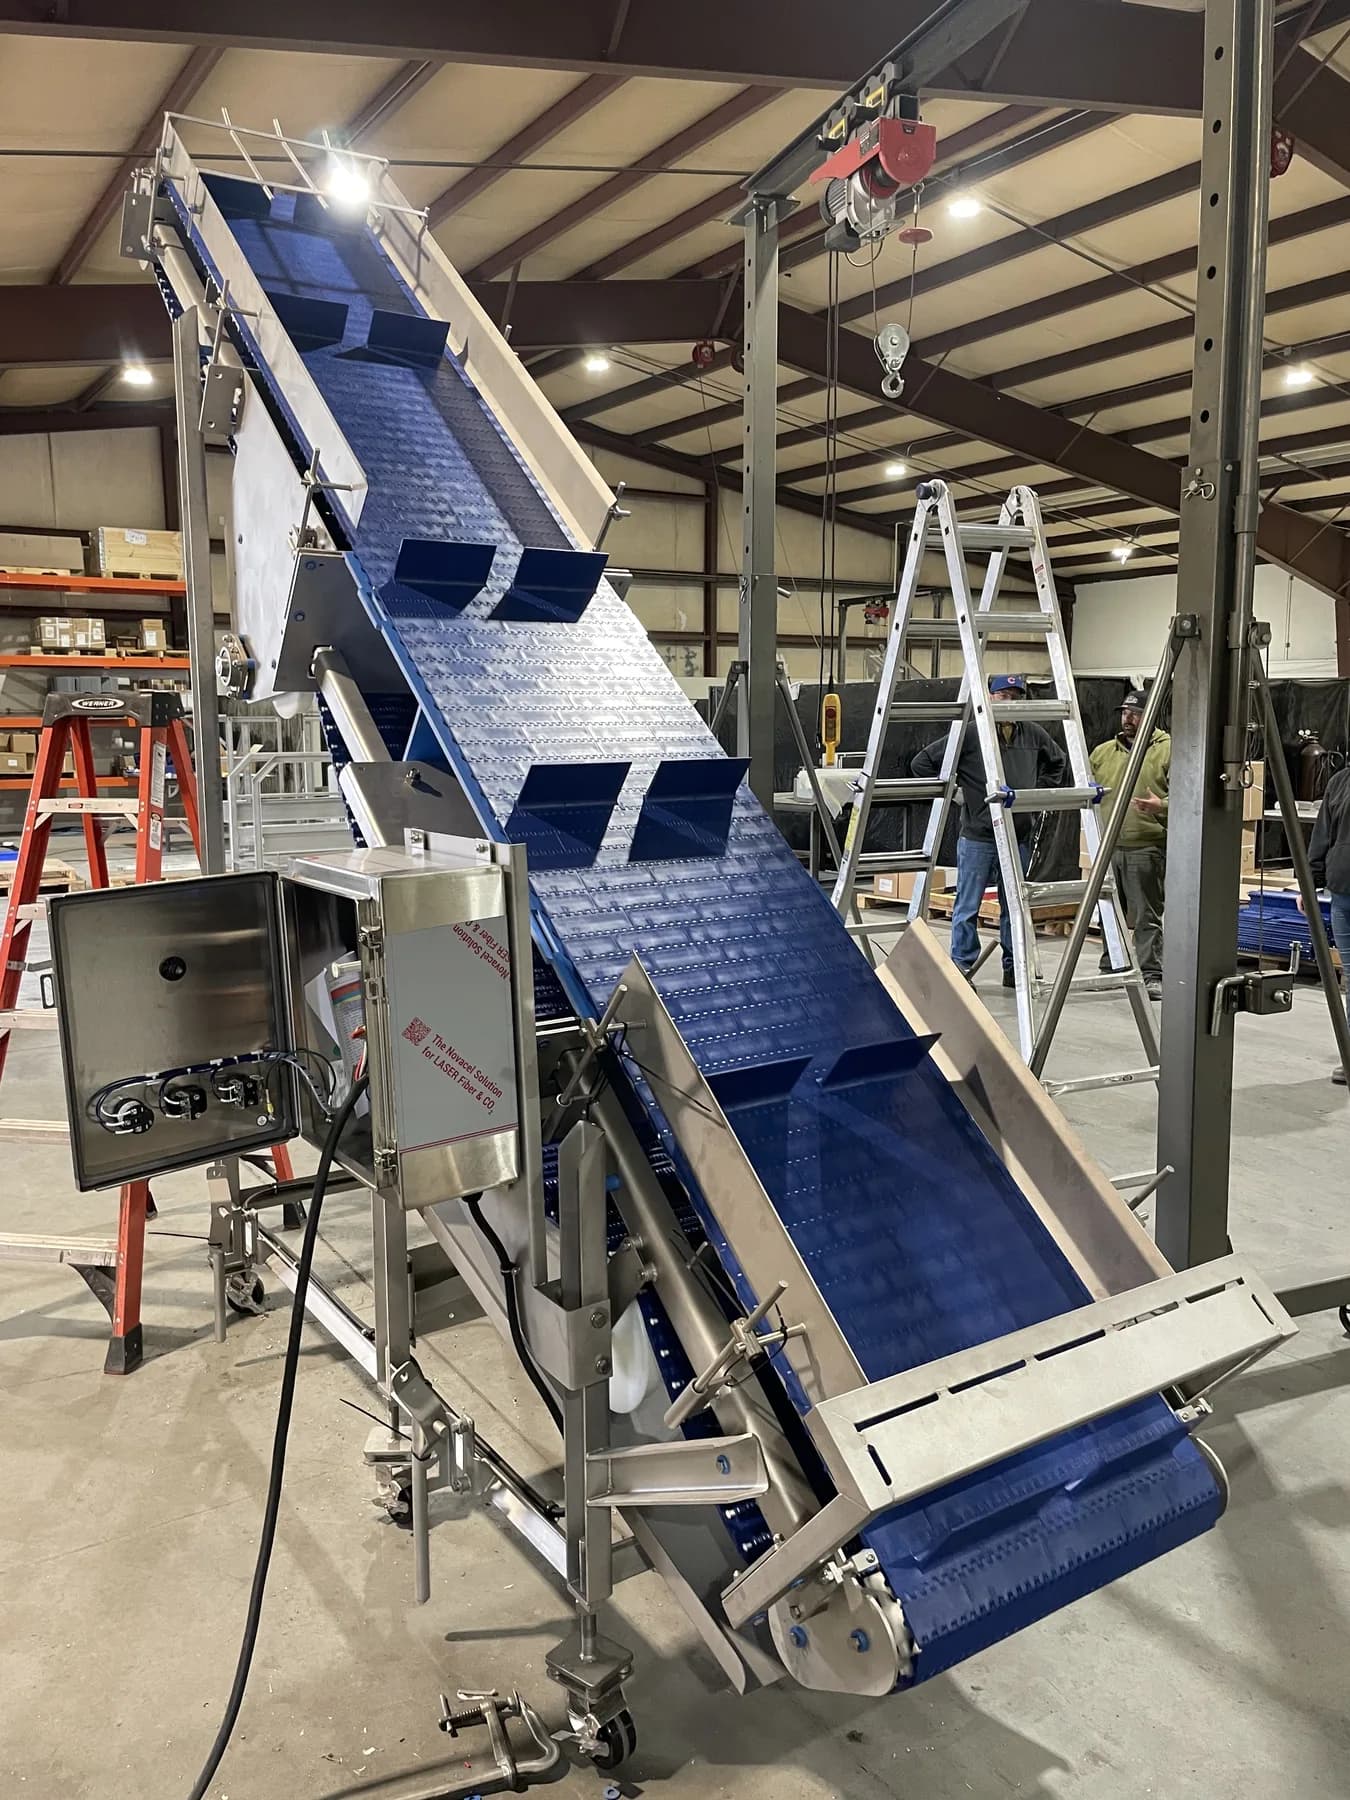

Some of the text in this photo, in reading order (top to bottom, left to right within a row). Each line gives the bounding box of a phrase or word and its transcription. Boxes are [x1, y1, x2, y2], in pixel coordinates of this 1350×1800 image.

[453, 924, 510, 980] Novacel Solution
[472, 923, 480, 933] &
[479, 930, 499, 950] Fiber
[422, 1046, 435, 1060] for
[433, 1055, 460, 1081] LASER
[457, 1075, 477, 1095] Fiber
[475, 1091, 484, 1101] &
[432, 1034, 503, 1098] The Novacel Solution
